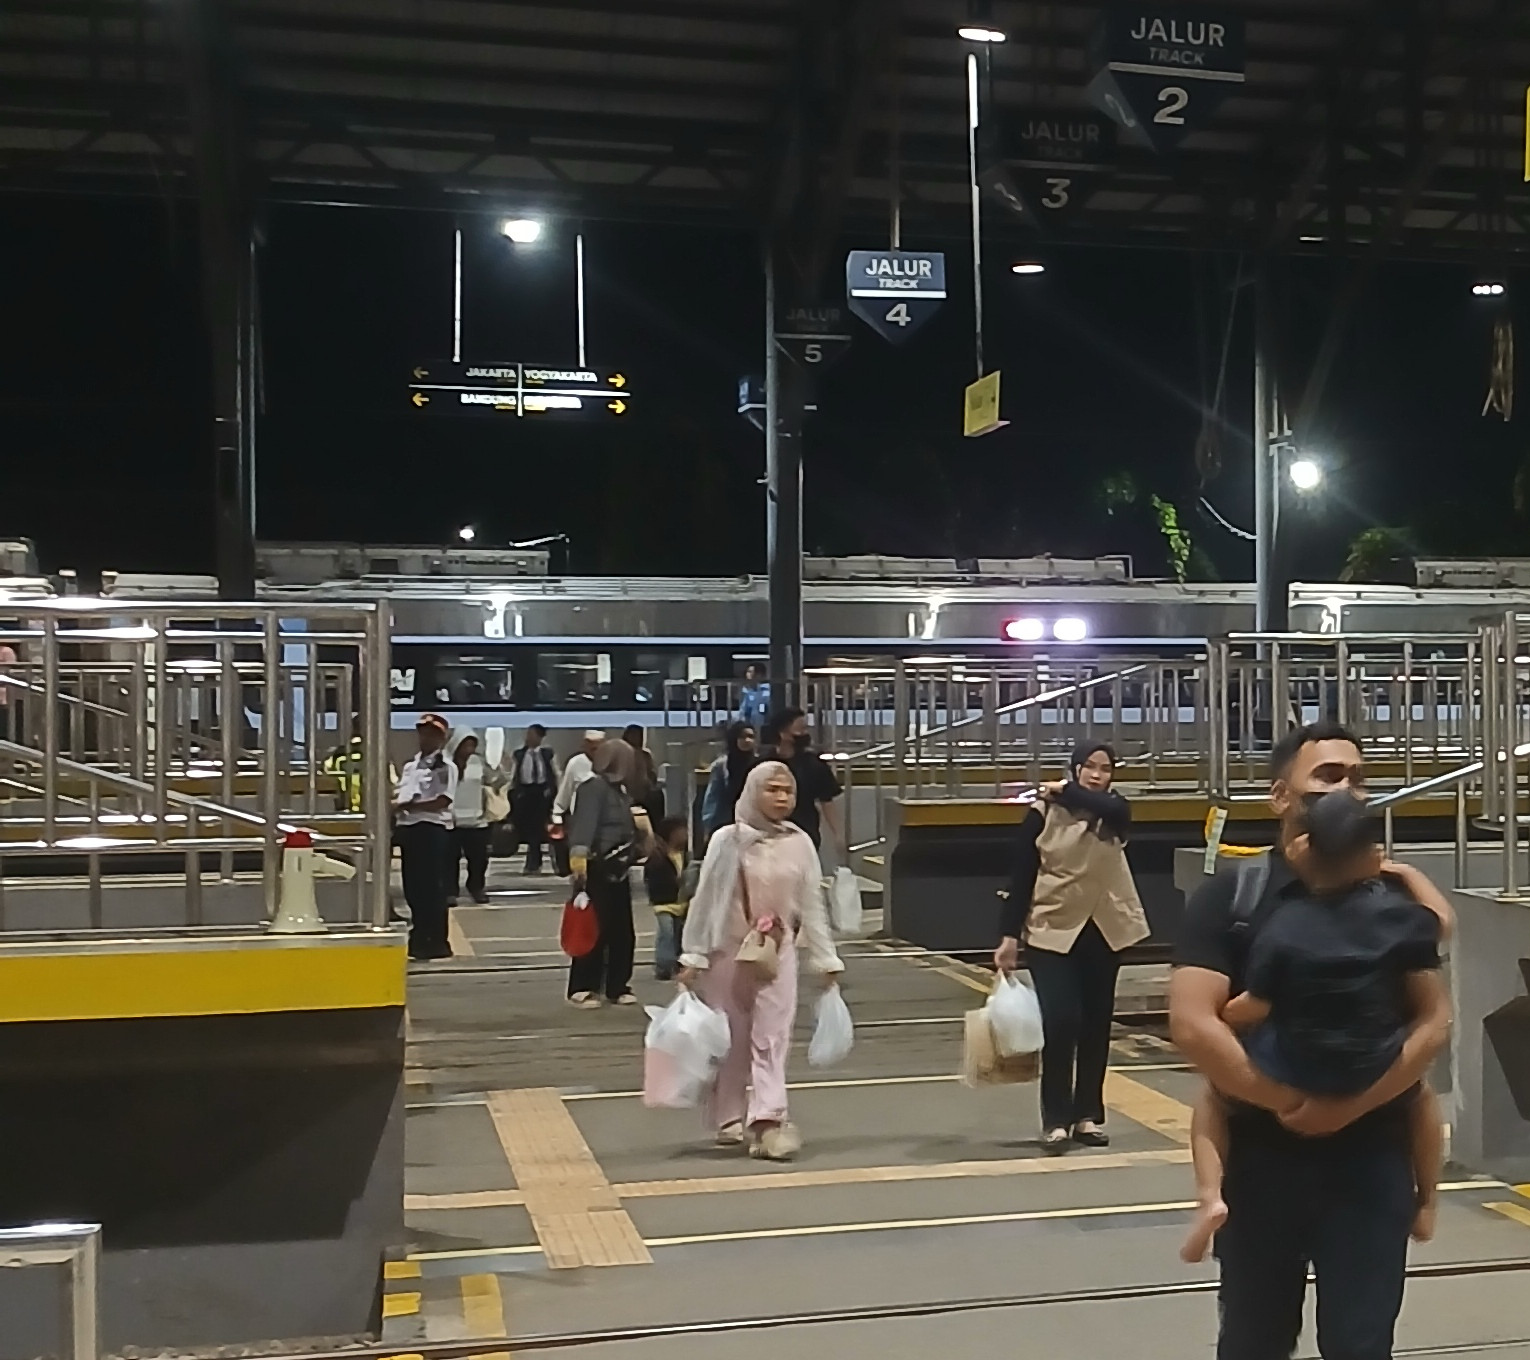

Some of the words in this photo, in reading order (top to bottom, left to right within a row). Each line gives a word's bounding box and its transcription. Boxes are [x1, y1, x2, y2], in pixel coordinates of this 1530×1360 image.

[1130, 17, 1226, 48] JALUR
[1149, 46, 1206, 66] TRACK
[1153, 86, 1189, 125] 2
[1041, 178, 1071, 209] 3
[865, 258, 932, 278] JALUR
[885, 303, 911, 327] 4
[804, 344, 822, 362] 5
